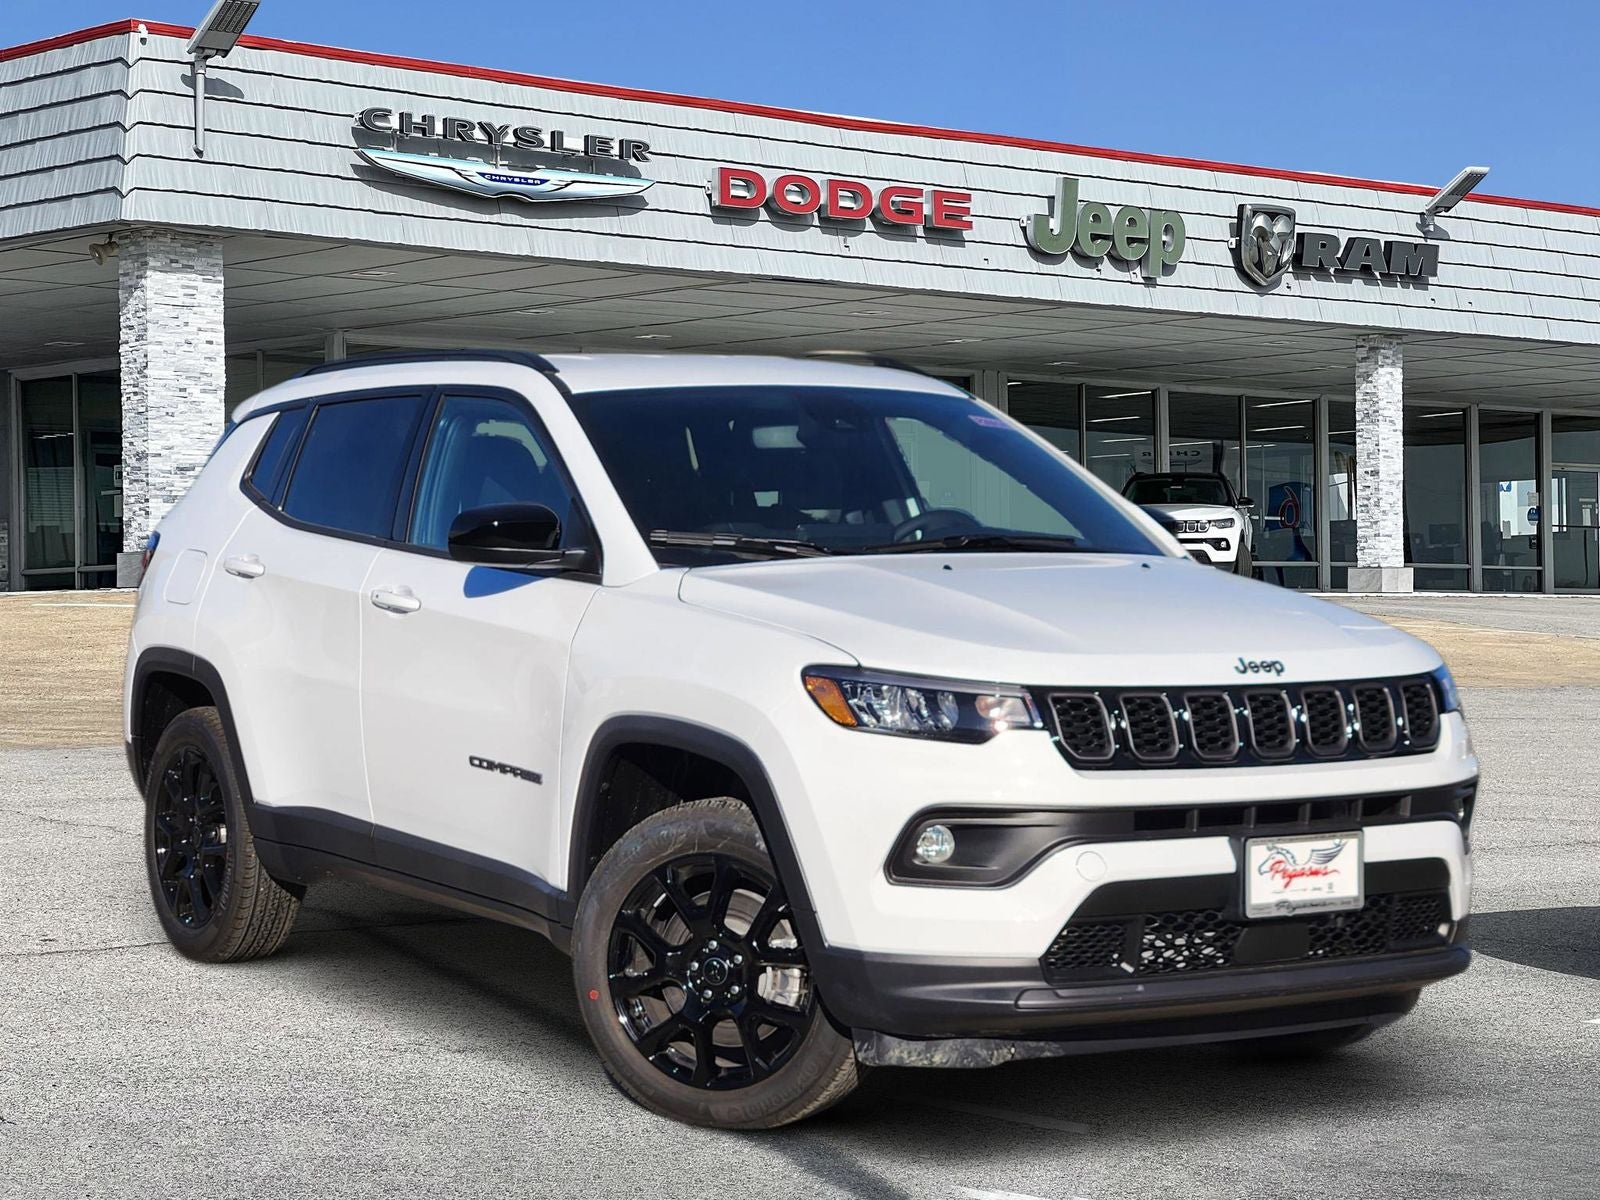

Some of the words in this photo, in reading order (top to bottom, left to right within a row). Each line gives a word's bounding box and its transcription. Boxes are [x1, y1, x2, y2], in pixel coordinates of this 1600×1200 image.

[357, 106, 650, 162] CHRYSLER
[484, 174, 541, 184] CHRYSLER
[711, 167, 973, 230] DODGE
[1026, 177, 1186, 278] Jeep
[1297, 232, 1440, 278] RAM
[1234, 656, 1285, 677] Jeep
